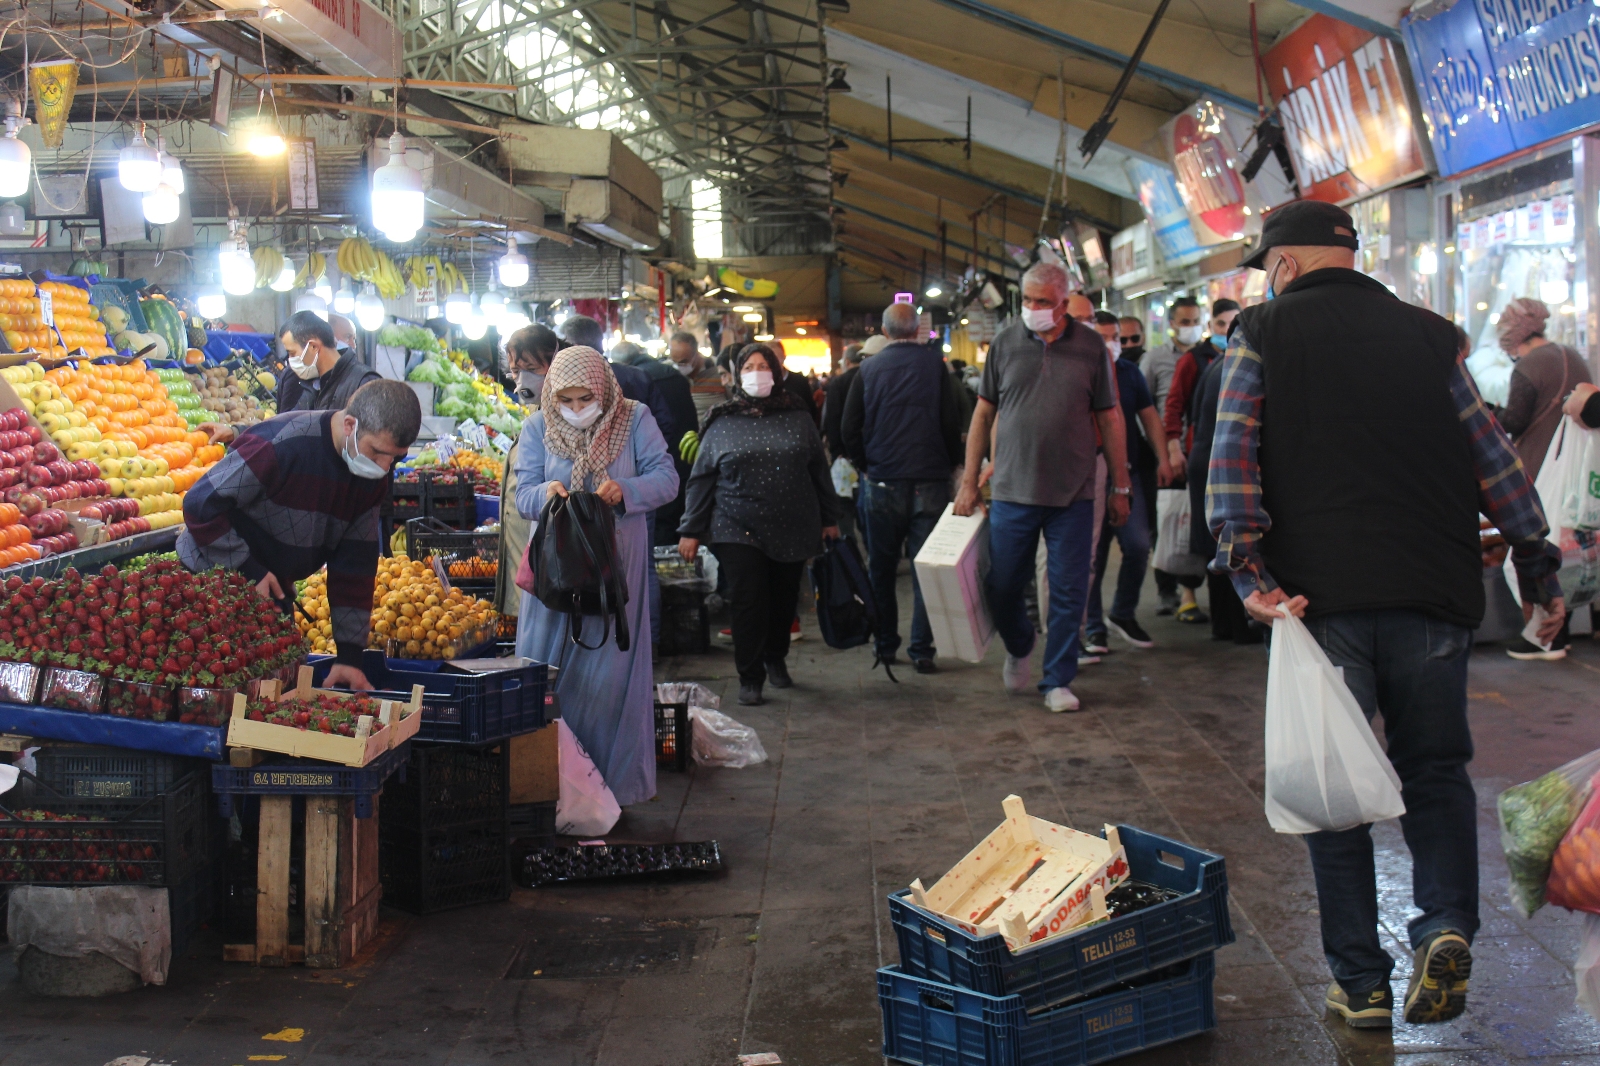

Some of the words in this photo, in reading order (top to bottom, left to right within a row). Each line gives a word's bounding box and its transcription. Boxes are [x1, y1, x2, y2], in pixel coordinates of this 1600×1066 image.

[1352, 36, 1397, 154] ET
[254, 772, 269, 785] 79
[271, 773, 333, 785] SEZERLER
[1081, 935, 1114, 963] TELLİ
[1113, 927, 1136, 942] 12-53
[1115, 938, 1137, 952] ANKARA
[1086, 1009, 1114, 1034] TELLİ
